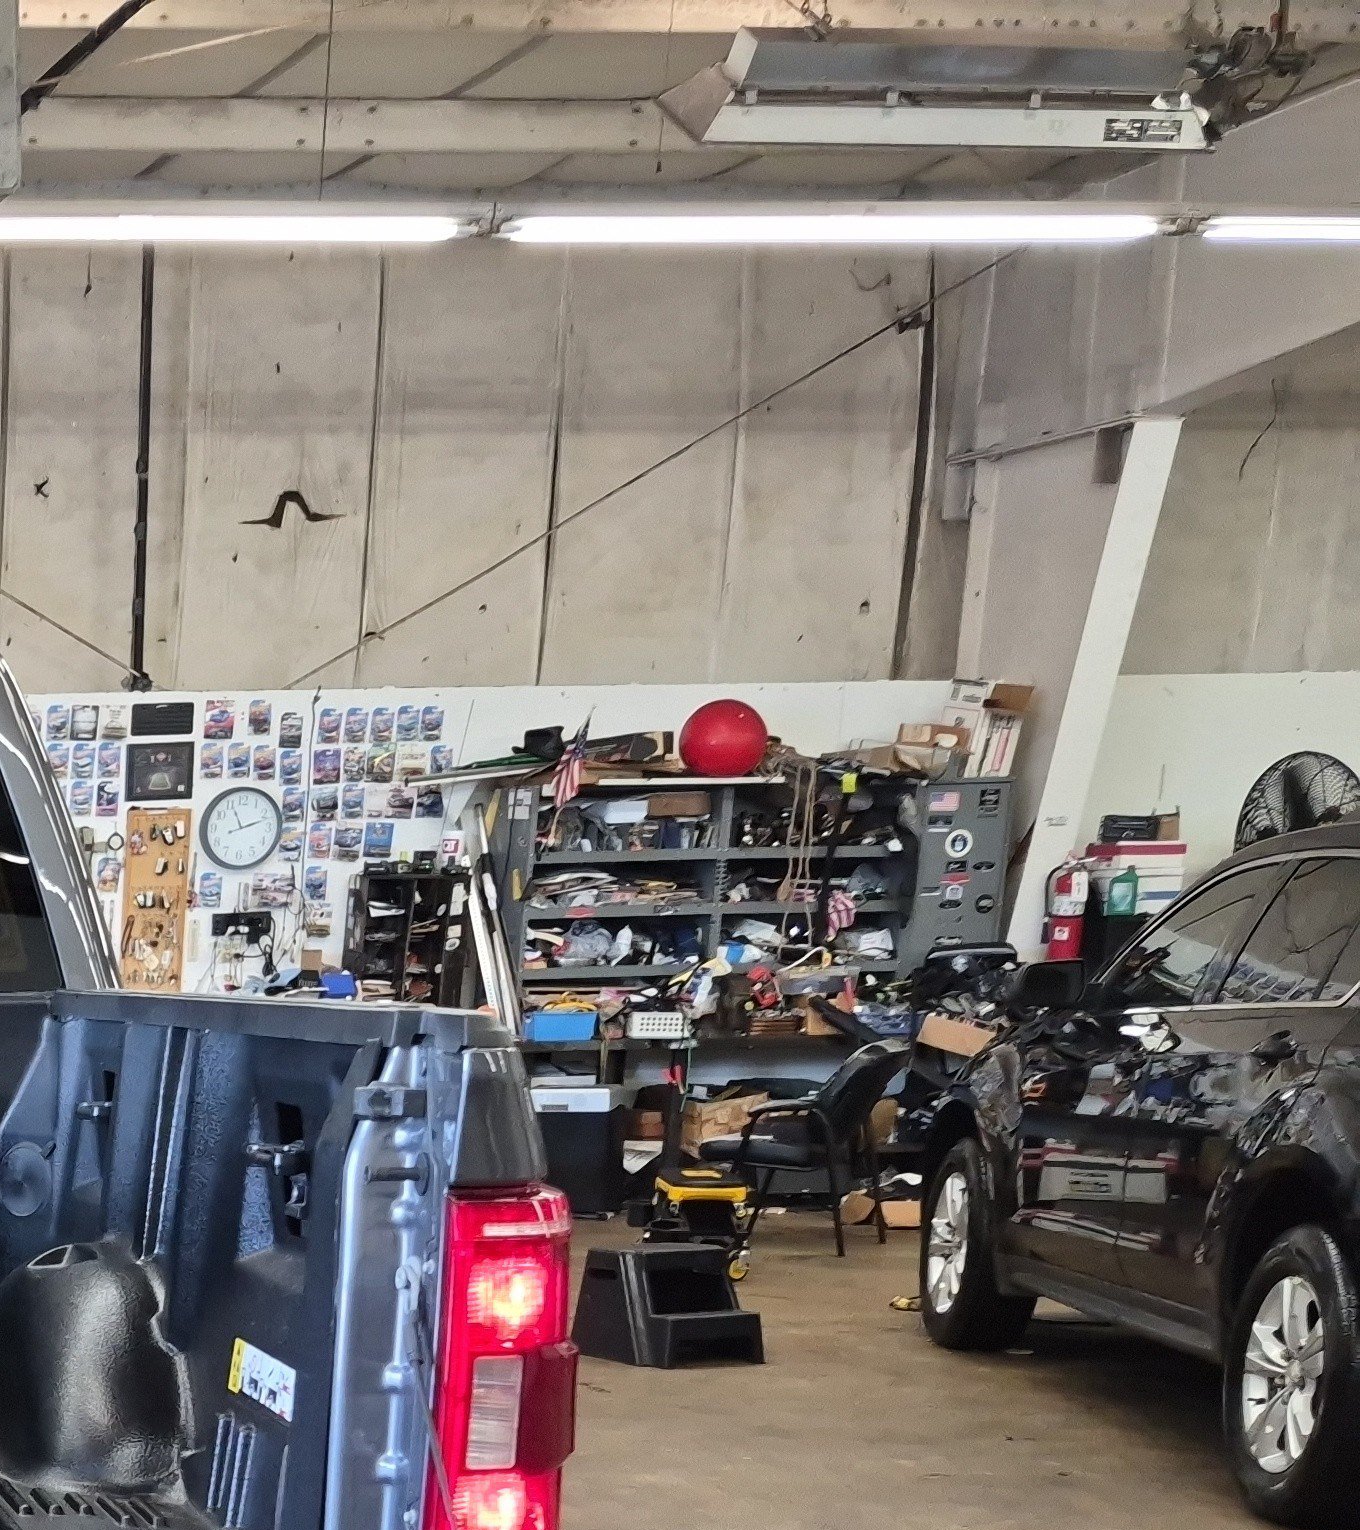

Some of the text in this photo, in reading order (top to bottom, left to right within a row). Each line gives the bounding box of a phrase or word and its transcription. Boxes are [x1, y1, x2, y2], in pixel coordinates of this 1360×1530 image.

[238, 794, 249, 806] 12
[217, 809, 227, 821] 10
[264, 821, 272, 833] 3
[235, 849, 243, 861] 6
